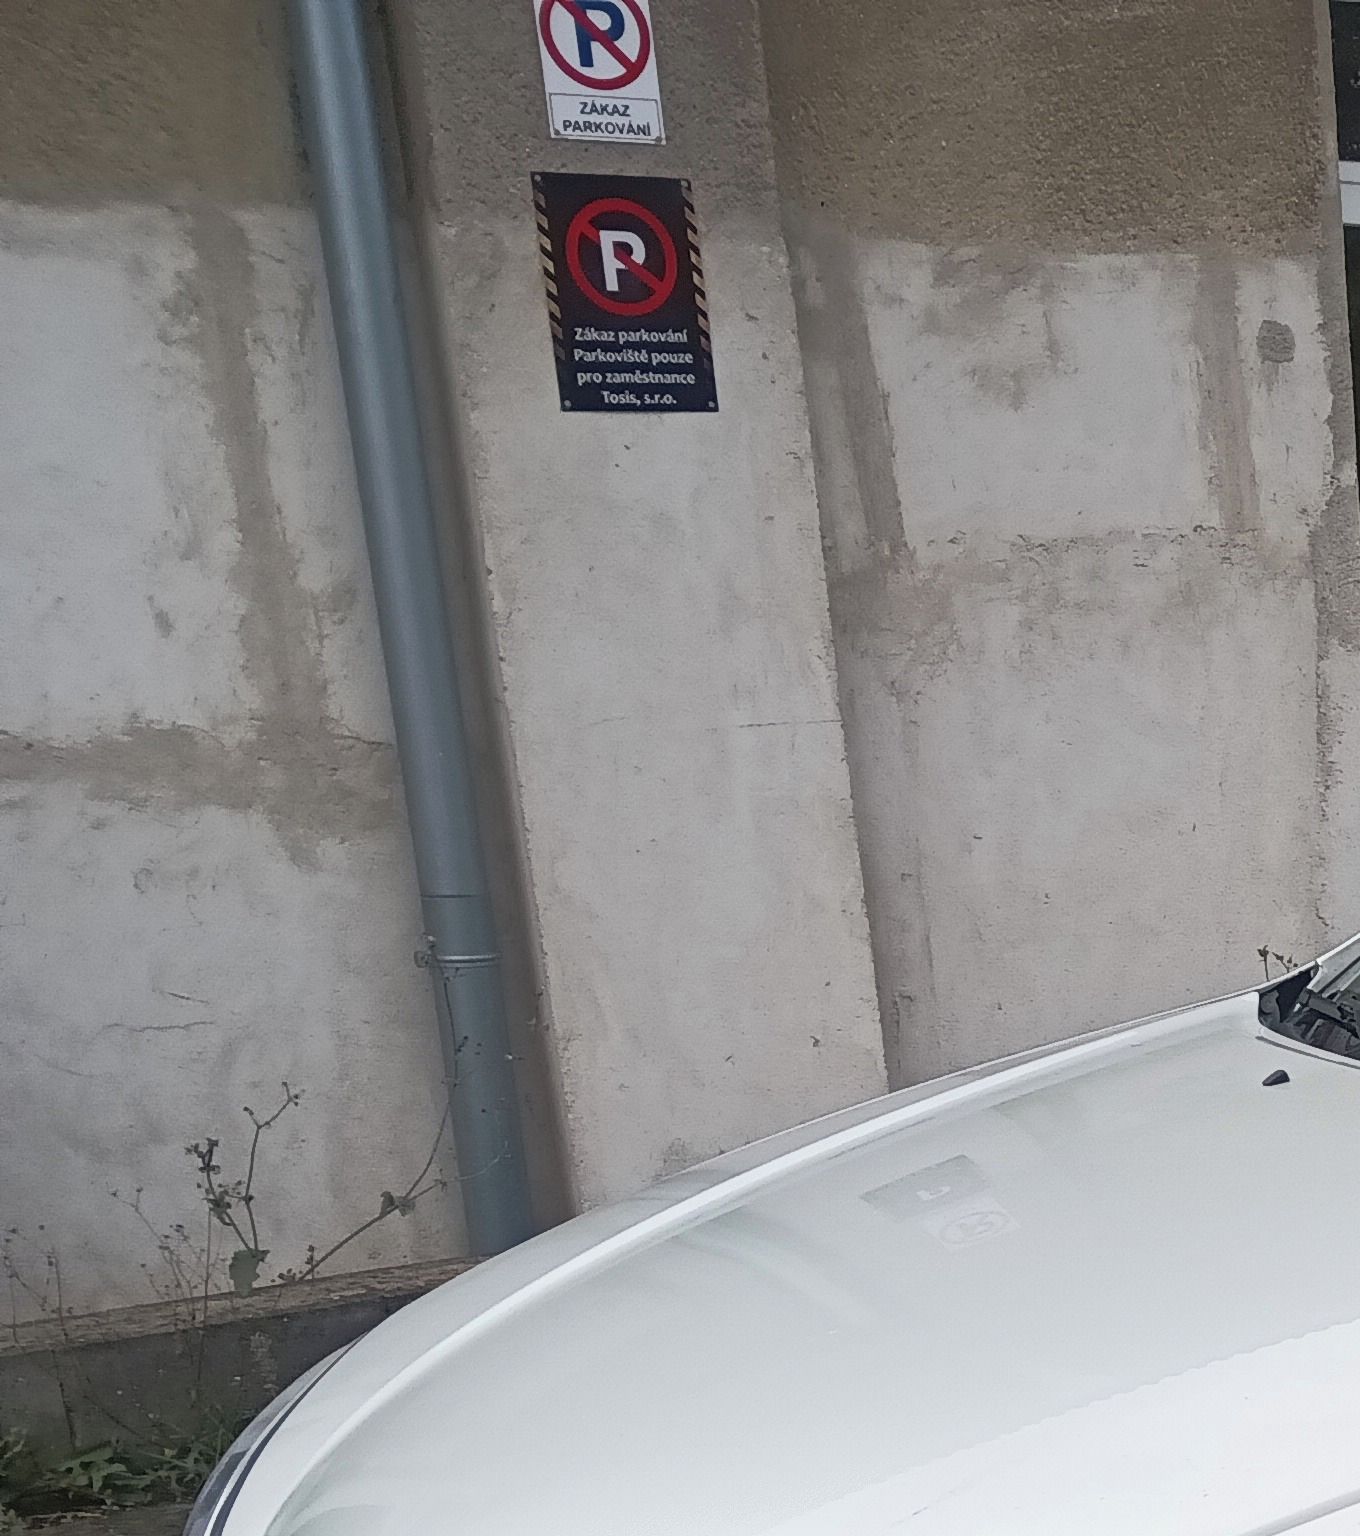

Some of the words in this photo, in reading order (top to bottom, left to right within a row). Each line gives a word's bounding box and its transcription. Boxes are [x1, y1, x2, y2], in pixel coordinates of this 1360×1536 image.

[579, 100, 631, 117] ZÁKAZ
[562, 120, 651, 137] PARKOVÁNÍ
[574, 327, 616, 342] Zákaz
[618, 328, 688, 345] parkování
[573, 348, 649, 363] Parkoviště
[651, 352, 694, 366] pouze
[577, 372, 603, 386] pro
[605, 370, 696, 385] zaměstnance
[601, 390, 641, 406] Tosis,
[644, 393, 677, 405] s.r.o.
